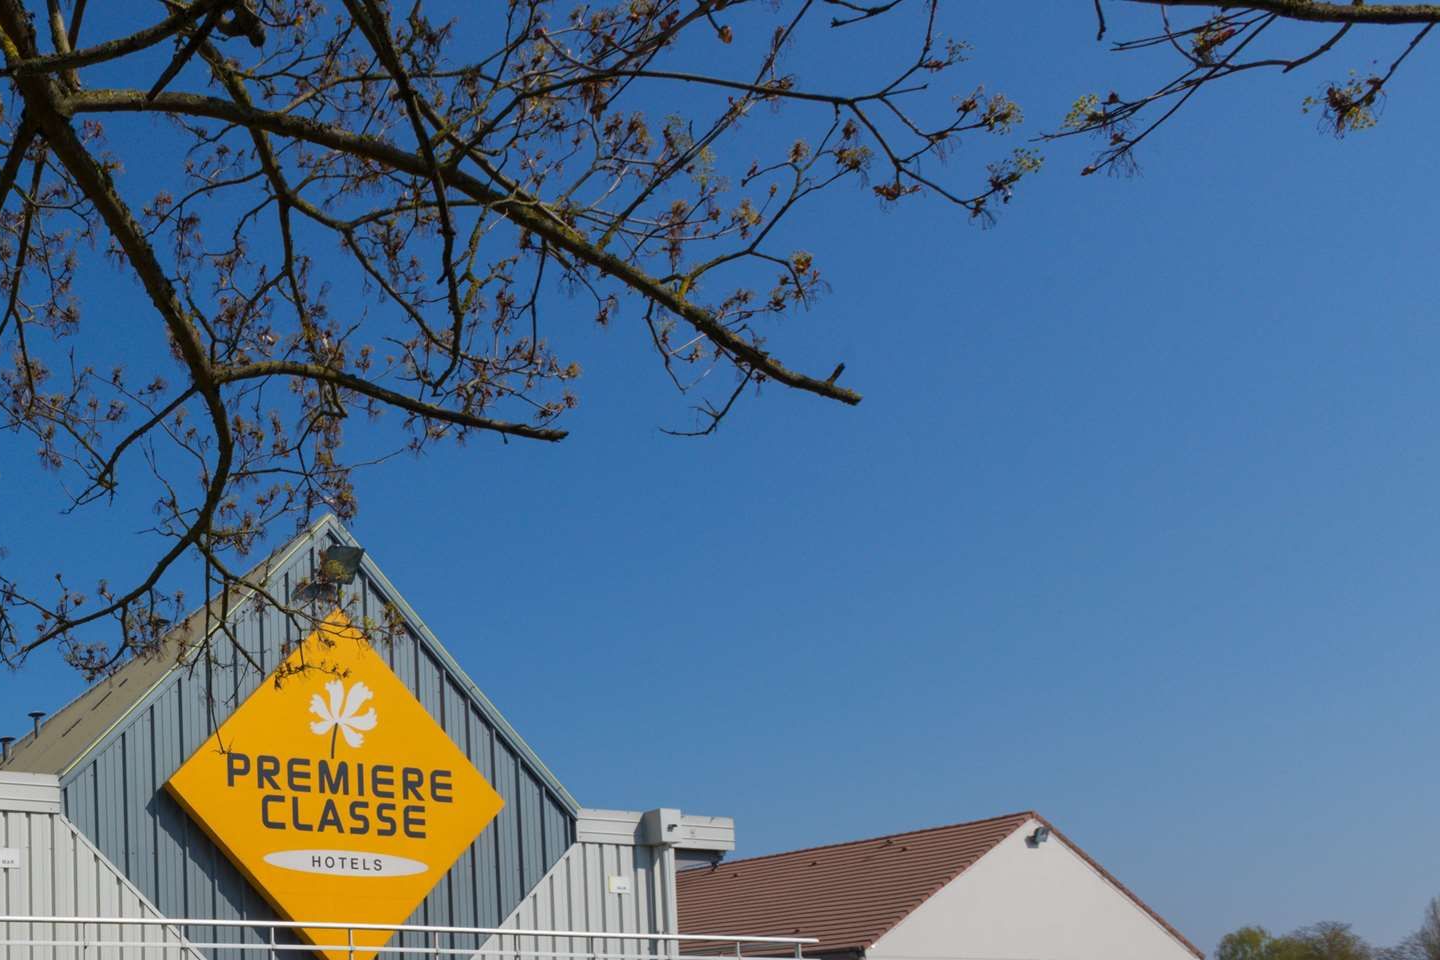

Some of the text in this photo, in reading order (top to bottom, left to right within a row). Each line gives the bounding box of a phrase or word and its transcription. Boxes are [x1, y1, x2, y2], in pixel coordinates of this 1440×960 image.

[226, 752, 453, 803] PREMIERE
[261, 794, 427, 839] CLASSE
[311, 855, 383, 872] HOTELS
